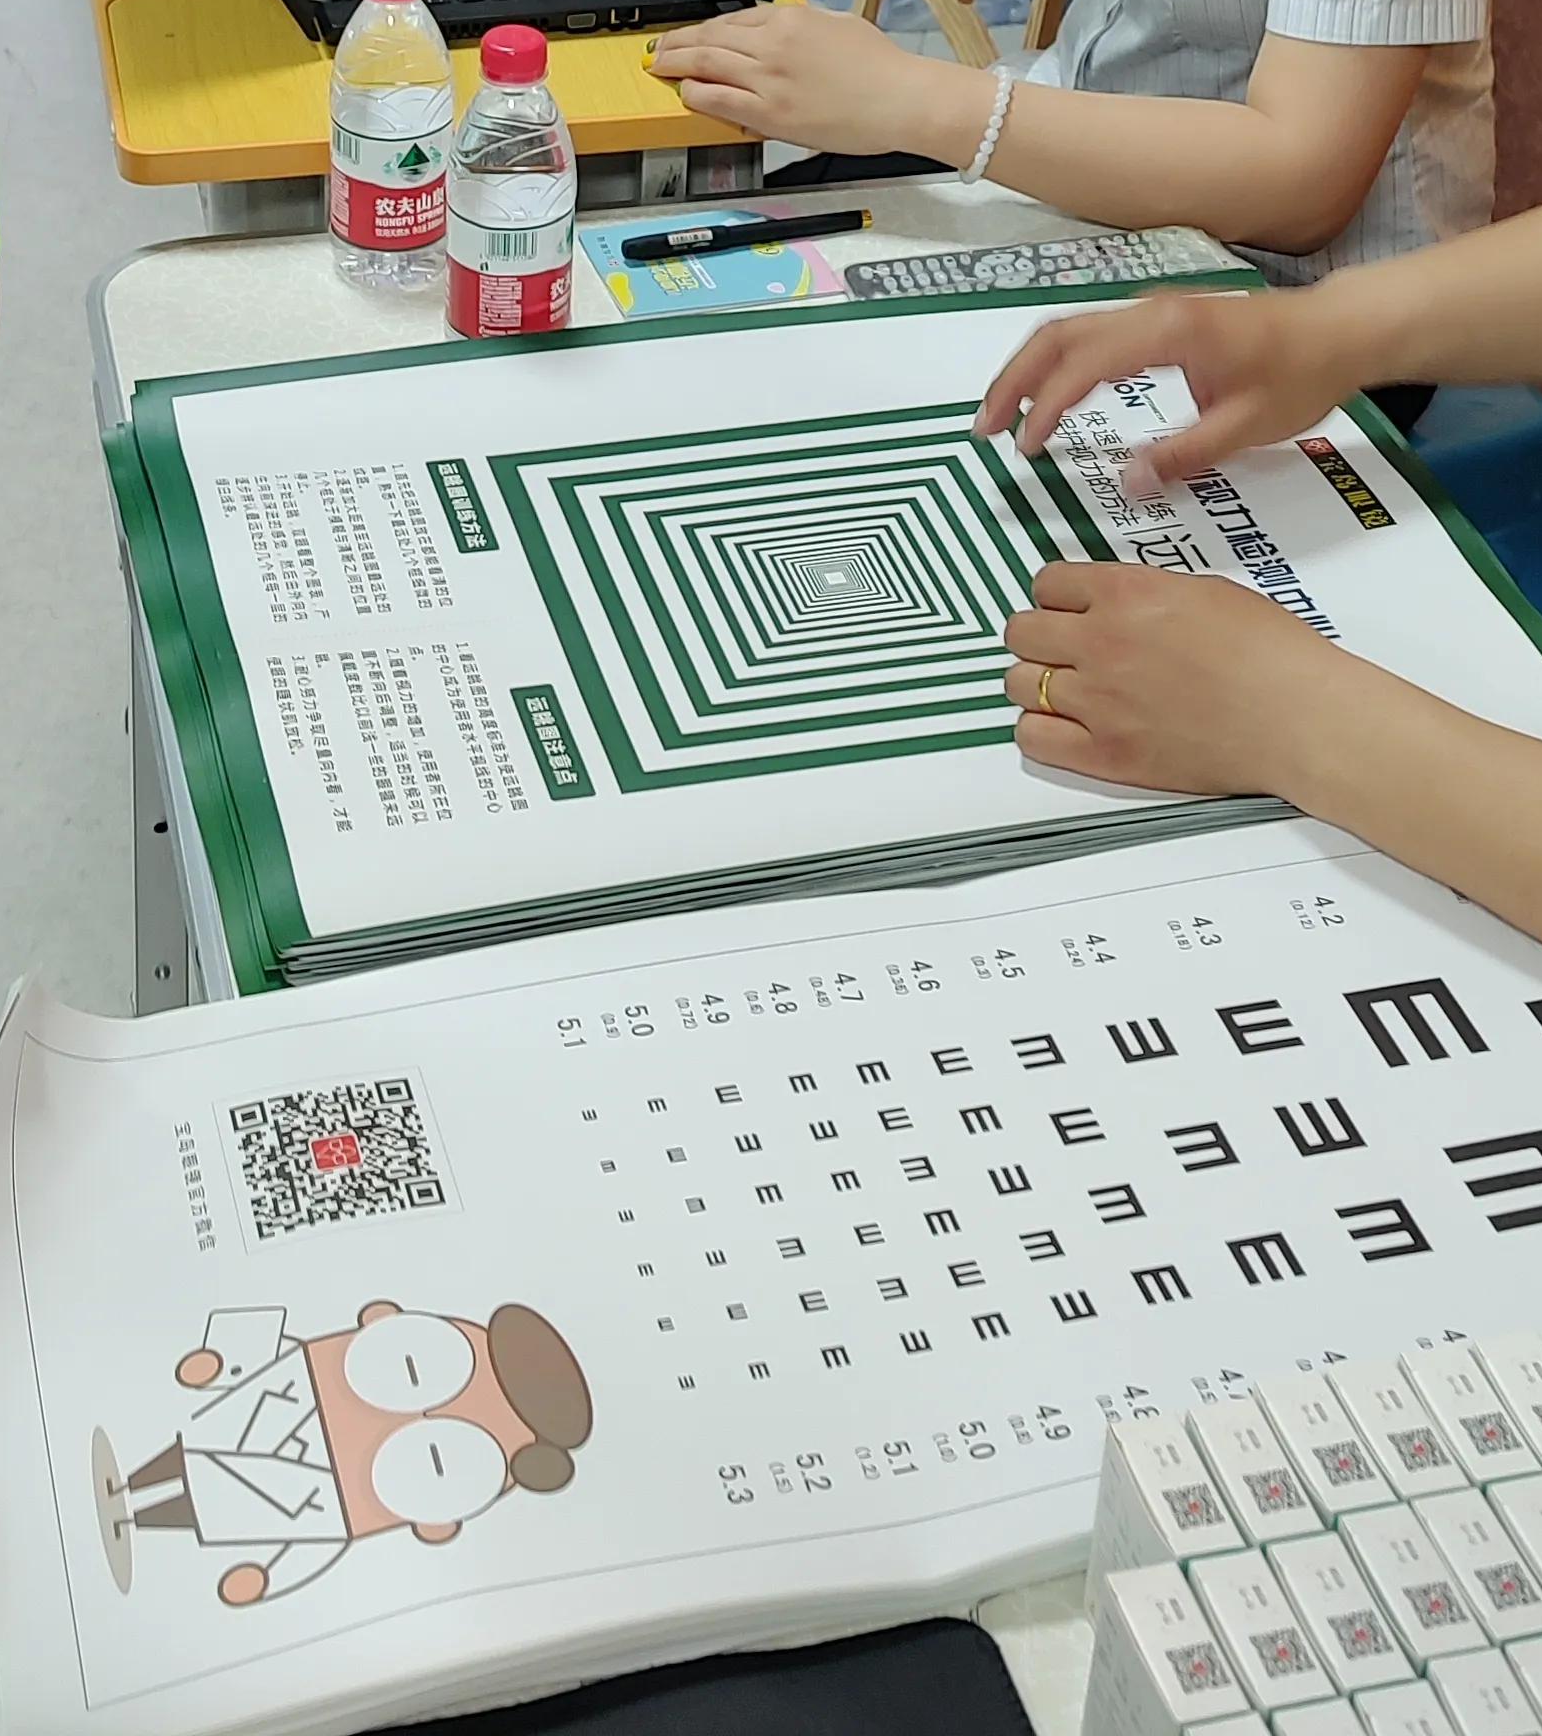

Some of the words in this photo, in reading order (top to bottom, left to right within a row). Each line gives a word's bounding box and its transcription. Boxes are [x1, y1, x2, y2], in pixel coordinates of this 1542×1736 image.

[524, 693, 581, 787] 远眺图注意点
[1314, 896, 1345, 927] 4.2
[1192, 916, 1223, 947] 4.3
[994, 948, 1026, 979] 4.5
[1085, 934, 1117, 964] 4.4
[834, 972, 865, 1002] 4.7
[910, 960, 941, 992] 4.6
[701, 994, 731, 1025] 4.9
[768, 982, 798, 1015] 4.8
[557, 1017, 587, 1048] 5.1
[624, 1004, 655, 1037] 5.0
[1036, 1405, 1072, 1441] 4.9
[959, 1420, 996, 1460] 5.0
[796, 1452, 832, 1493] 5.2
[883, 1440, 919, 1476] 5.1
[718, 1464, 754, 1504] 5.3
